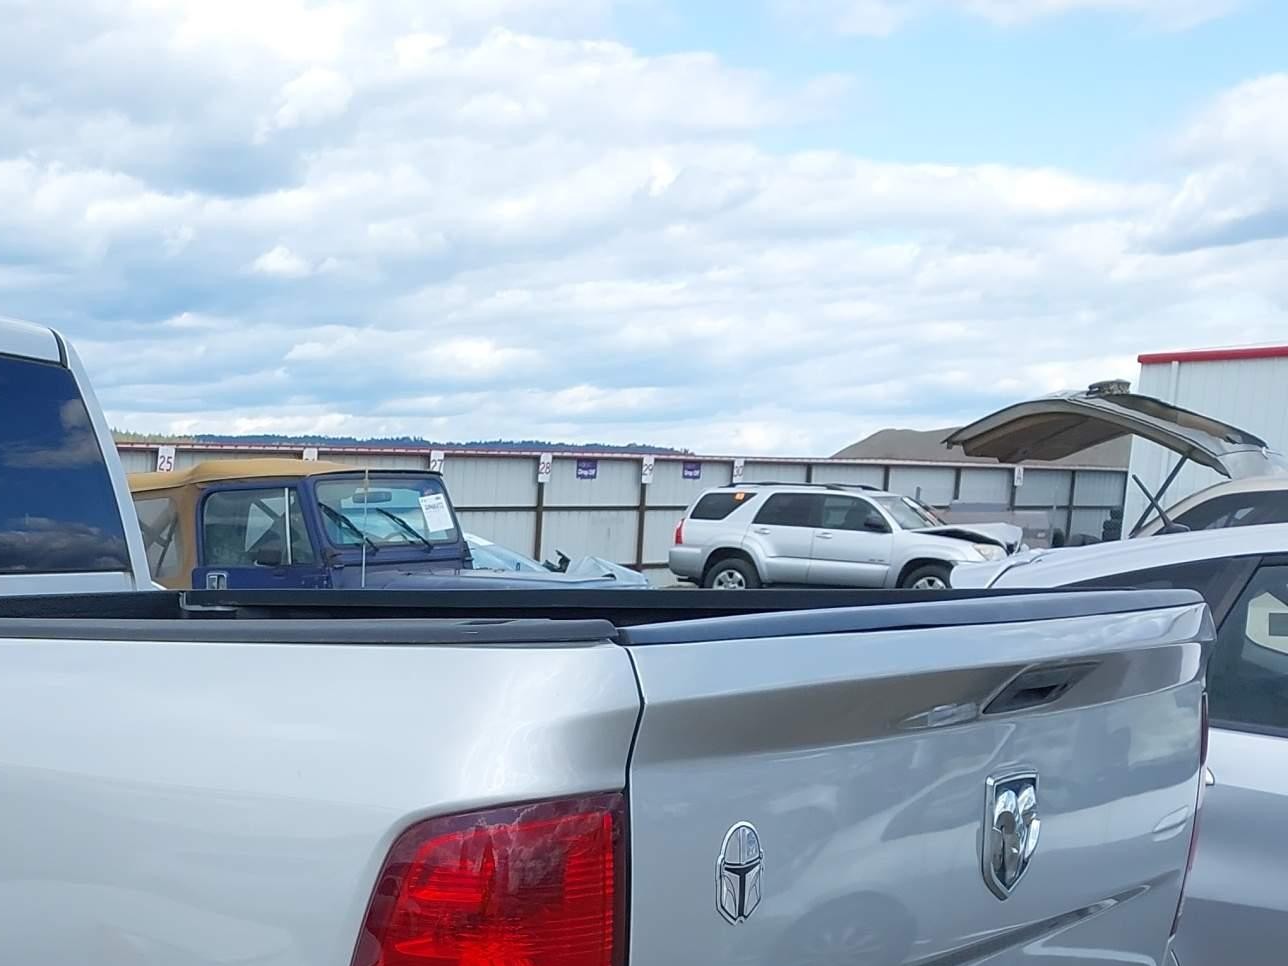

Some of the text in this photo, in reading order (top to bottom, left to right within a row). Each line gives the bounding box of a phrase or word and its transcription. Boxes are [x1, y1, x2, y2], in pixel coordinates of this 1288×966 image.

[158, 455, 173, 471] 25
[431, 459, 443, 471] 27
[538, 462, 551, 475] 28
[642, 463, 653, 476] 29
